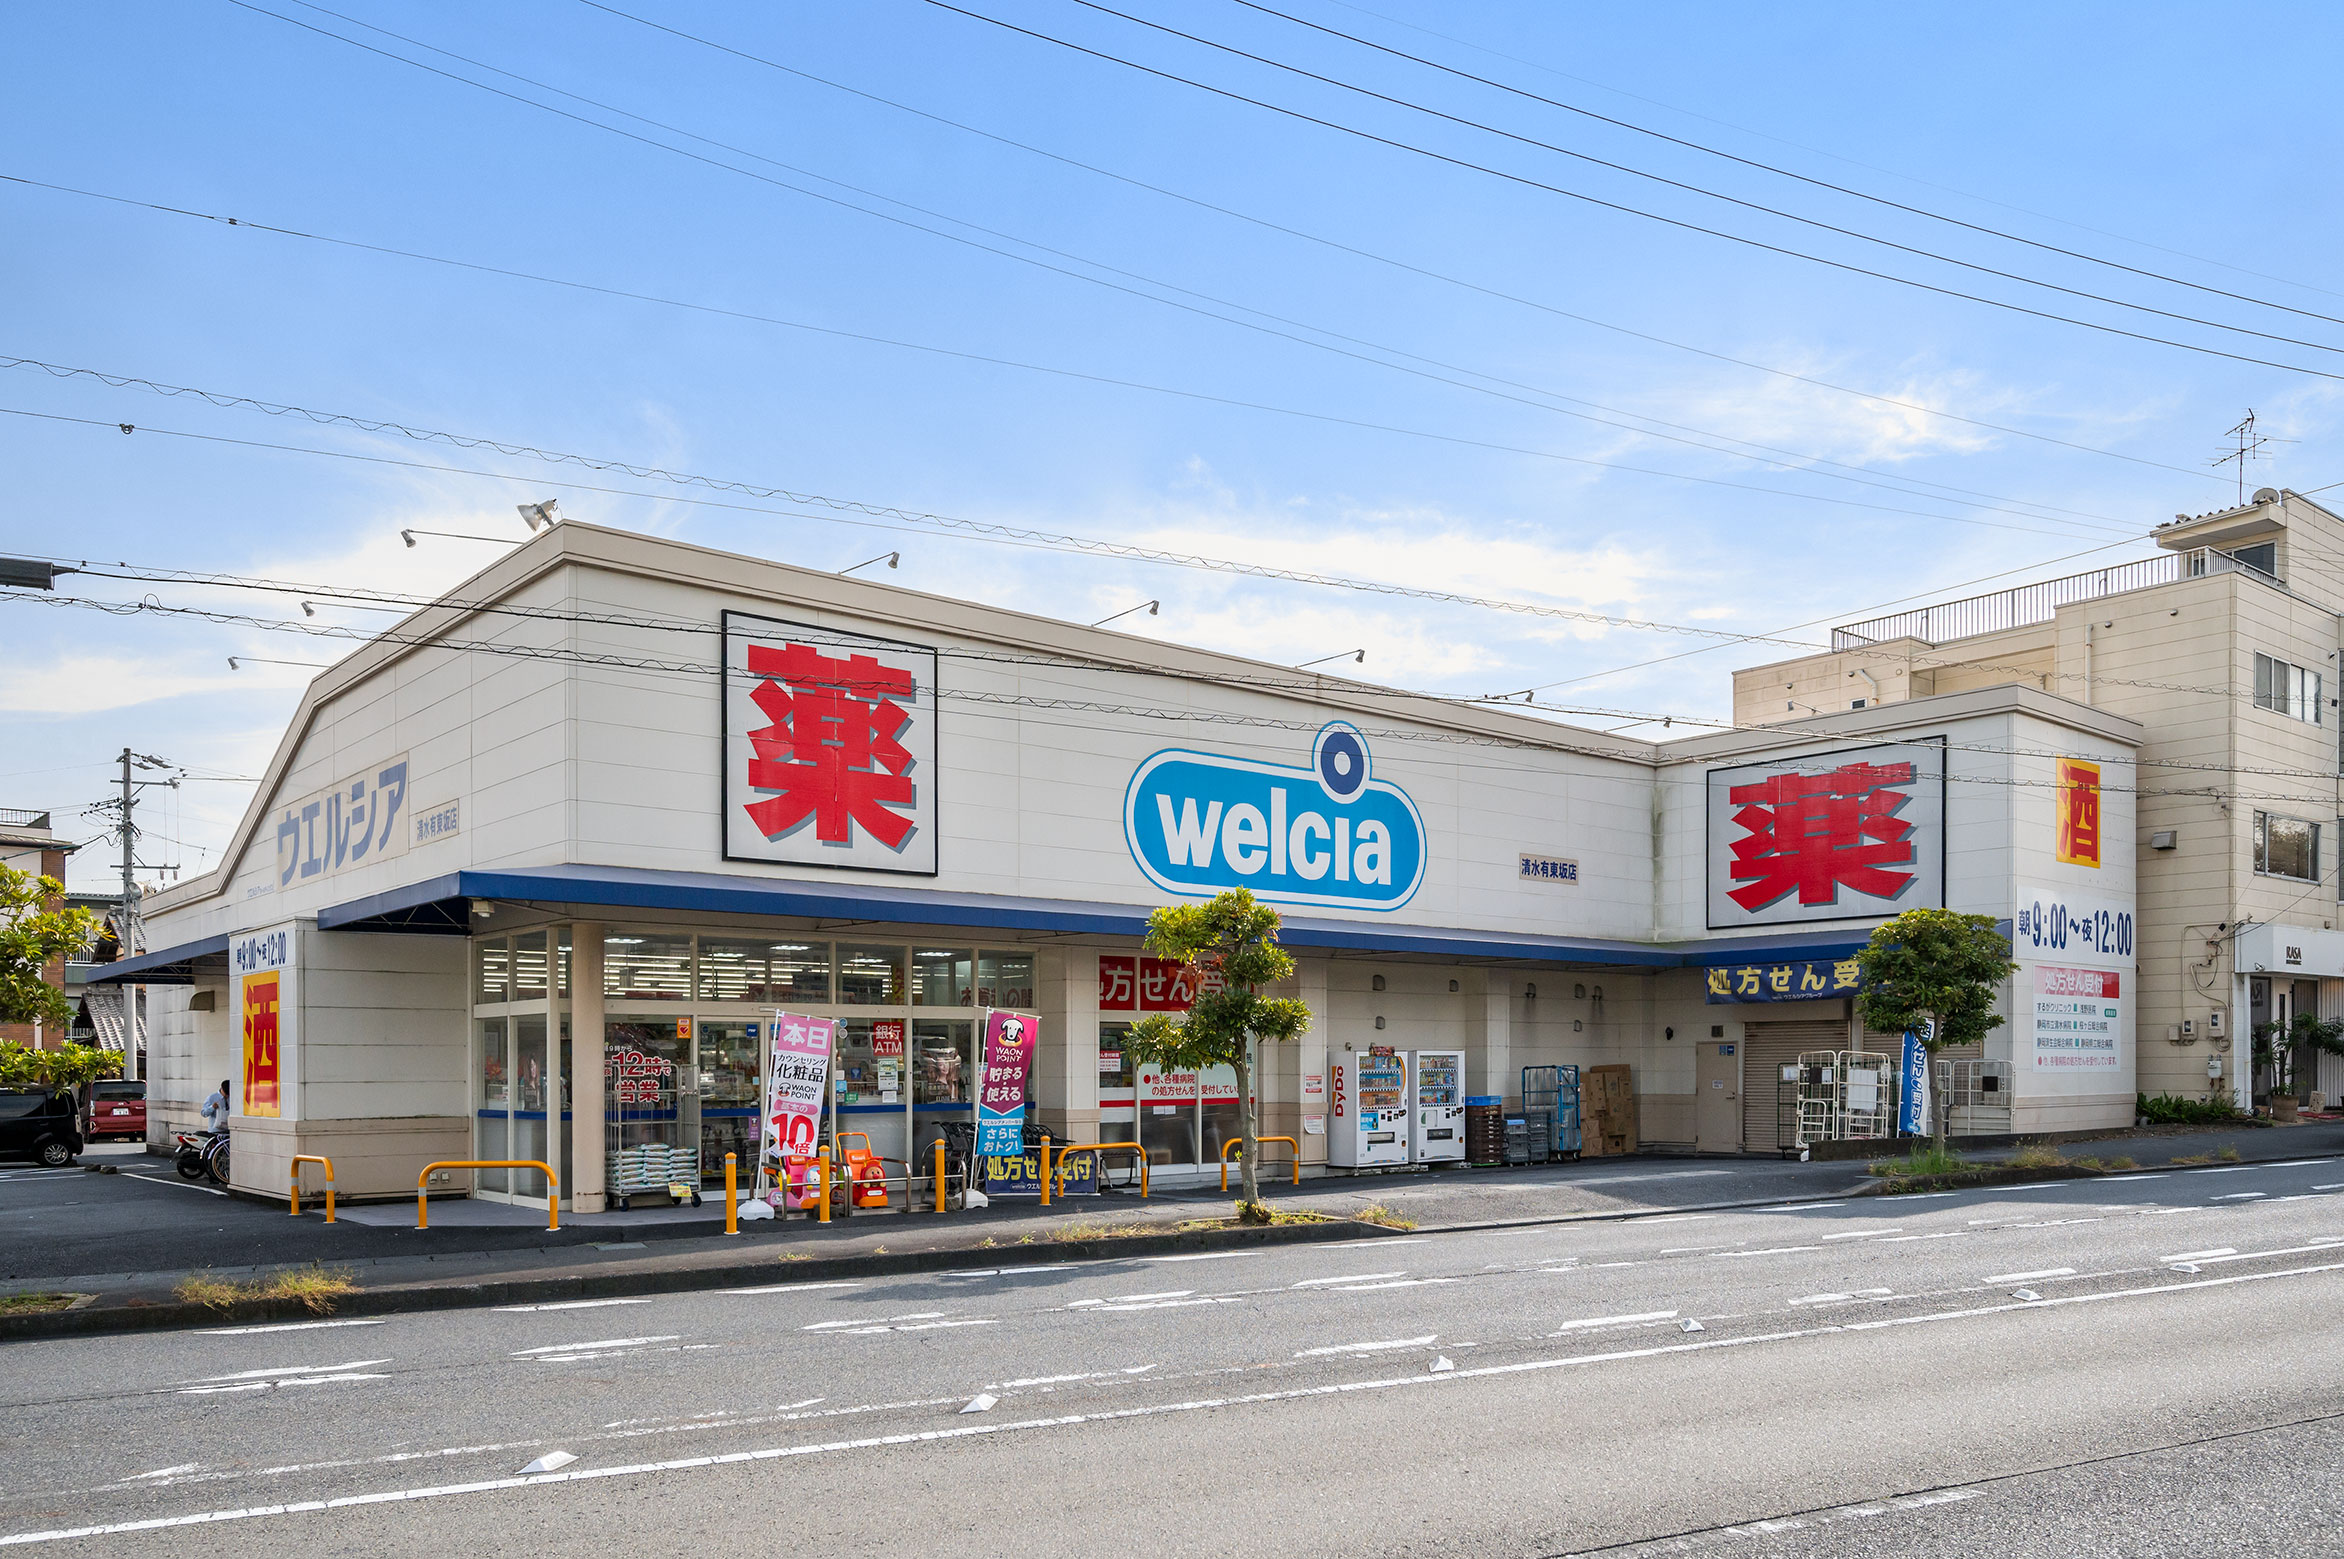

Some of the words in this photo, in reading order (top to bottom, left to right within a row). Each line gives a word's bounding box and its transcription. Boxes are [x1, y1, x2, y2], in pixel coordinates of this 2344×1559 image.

[743, 642, 919, 854] 薬
[2059, 762, 2098, 862] 酒
[278, 761, 407, 887] ウエルシア
[416, 807, 458, 842] 清水有東坂店
[1156, 787, 1391, 885] welcia
[1725, 761, 1919, 913] 薬
[1521, 858, 1577, 881] 清水有東坂店
[2286, 946, 2302, 960] RASA
[1099, 964, 1226, 1003] 方せん受
[1707, 959, 1862, 996] 処方せん受
[2045, 970, 2104, 995] 処方せん受付
[783, 1023, 829, 1050] 本日
[875, 1025, 902, 1041] 銀行
[245, 982, 278, 1109] 酒
[874, 1041, 903, 1054] ATM
[995, 1047, 1024, 1056] WAON
[778, 1054, 827, 1067] カウンセリング
[996, 1055, 1022, 1063] POINT
[776, 1063, 824, 1083] 化粧品
[989, 1066, 1023, 1083] 貯まる
[1152, 1074, 1195, 1085] 他、各種病院
[615, 1079, 661, 1103] 営業
[790, 1091, 816, 1101] POINT
[791, 1084, 817, 1094] WAON
[986, 1086, 1021, 1103] 使える
[1334, 1066, 1346, 1117] DyDo
[986, 1128, 1019, 1140] さらに
